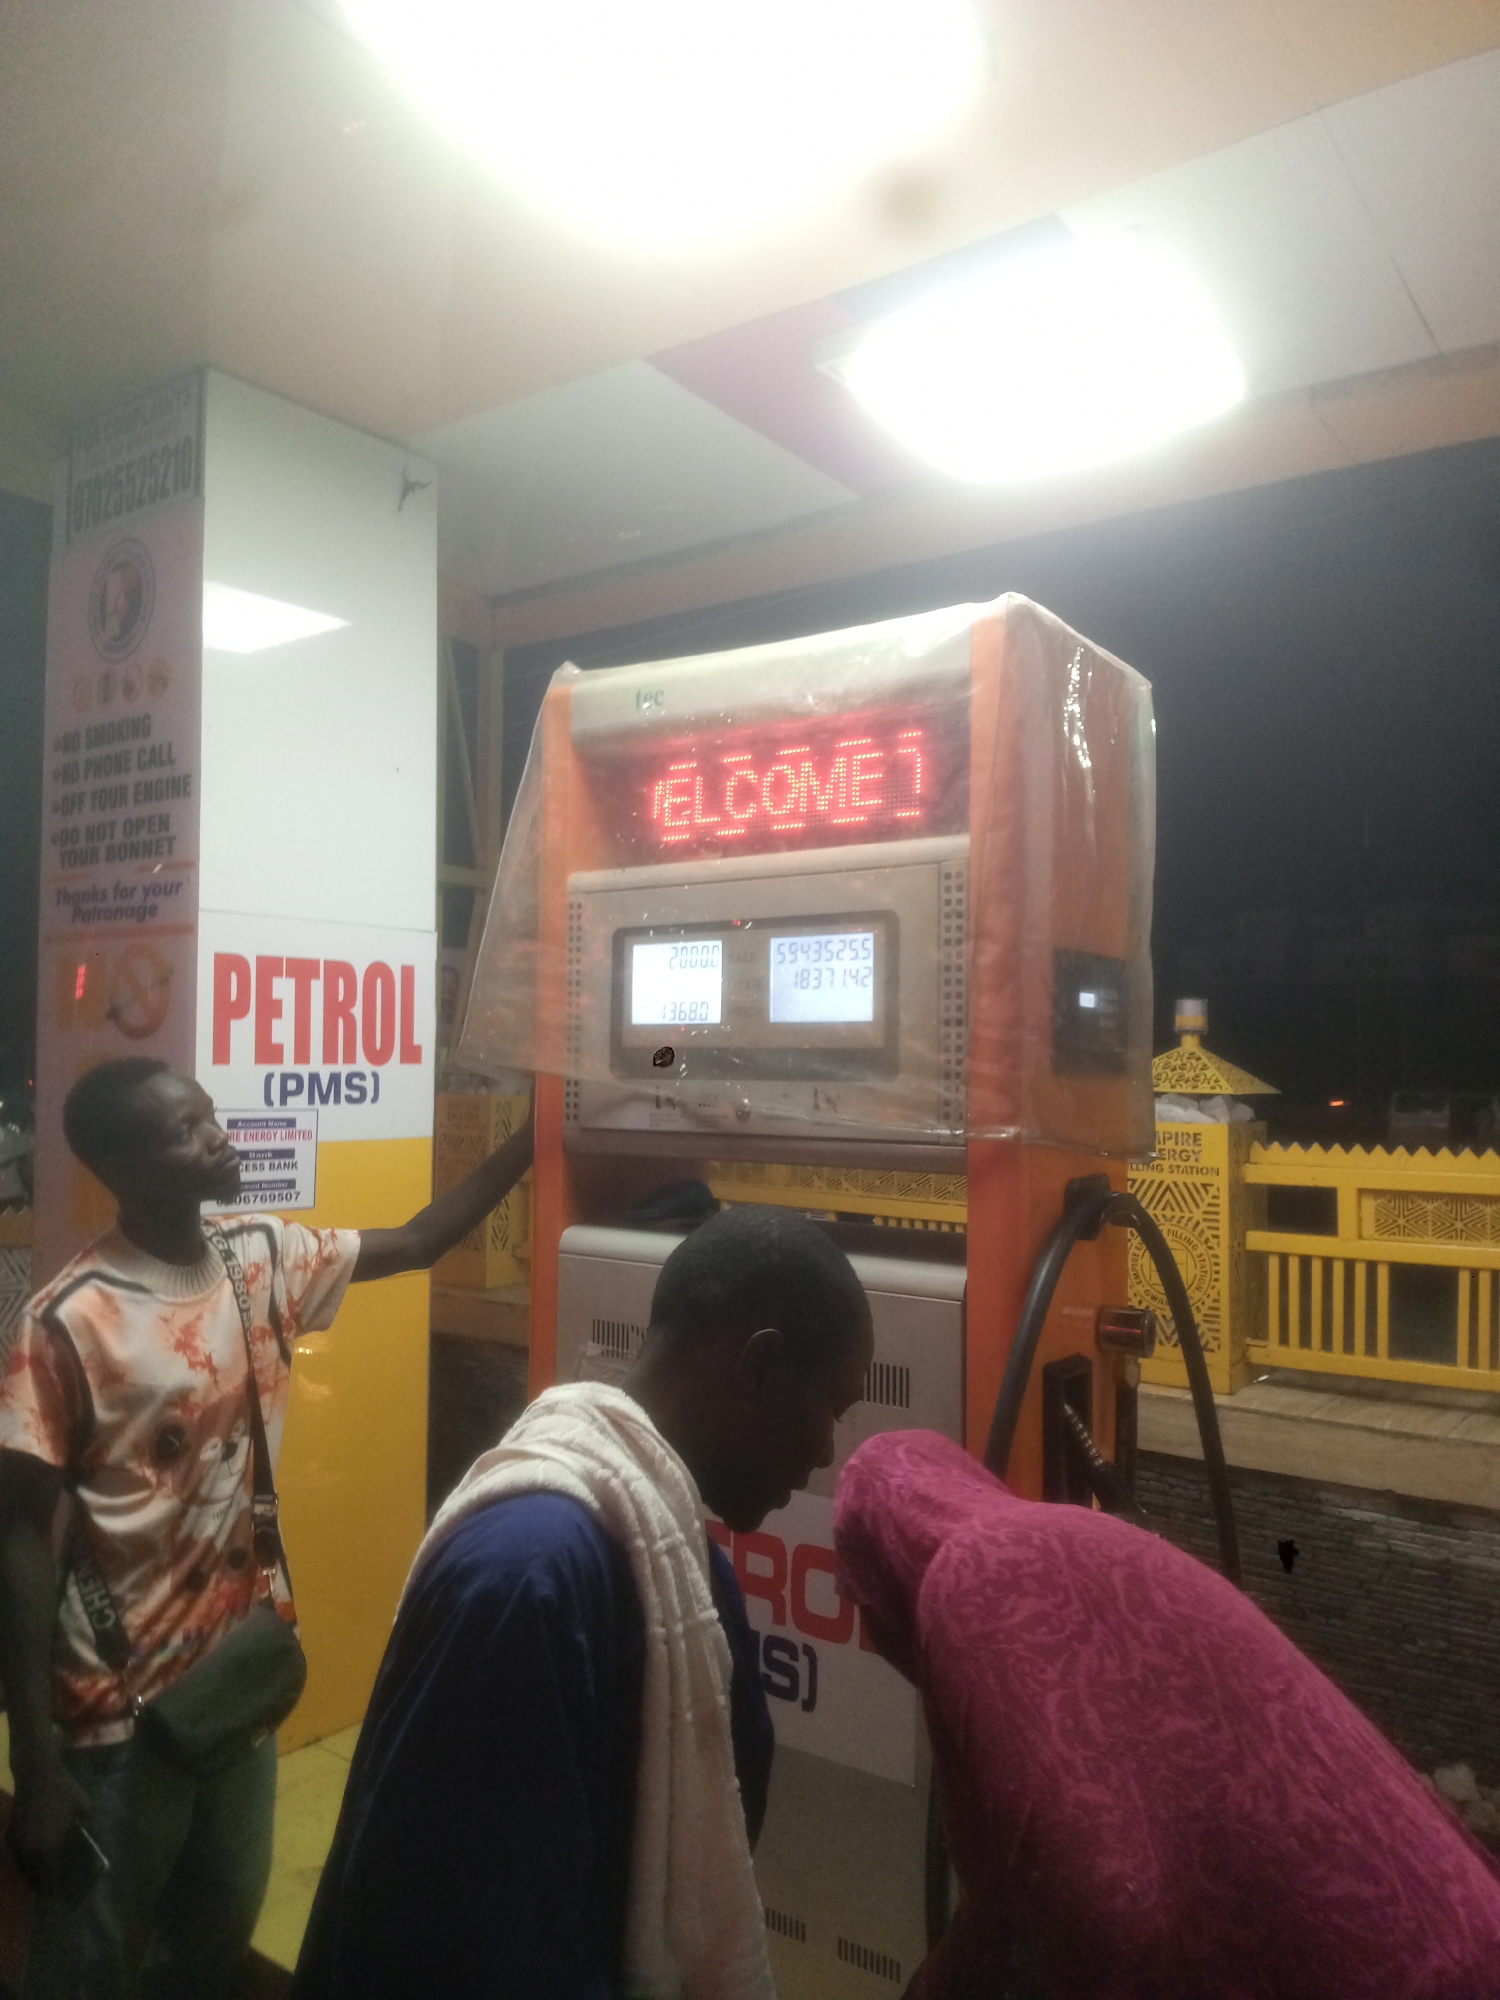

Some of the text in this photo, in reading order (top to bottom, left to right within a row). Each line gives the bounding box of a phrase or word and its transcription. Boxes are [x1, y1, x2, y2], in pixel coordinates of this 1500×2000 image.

[62, 714, 151, 755] NO SMOKING
[62, 742, 176, 786] NO PHONE CALL
[61, 773, 192, 817] OFF YOUR ENGINE
[59, 813, 170, 847] DO NOT OPEN
[59, 835, 176, 869] YOUR BONNET
[55, 881, 183, 906] Thanks for your
[72, 904, 158, 924] Patronage
[212, 951, 422, 1067] PETROL
[263, 1070, 380, 1107] (PMS)
[229, 1129, 313, 1142] RE ENERGY LIMITED
[240, 1161, 299, 1172] CESS BANK
[249, 1151, 273, 1159] Bank
[1157, 1148, 1203, 1162] ERGY
[1129, 1162, 1220, 1177] LLING STATION
[1167, 1228, 1199, 1252] FILLING
